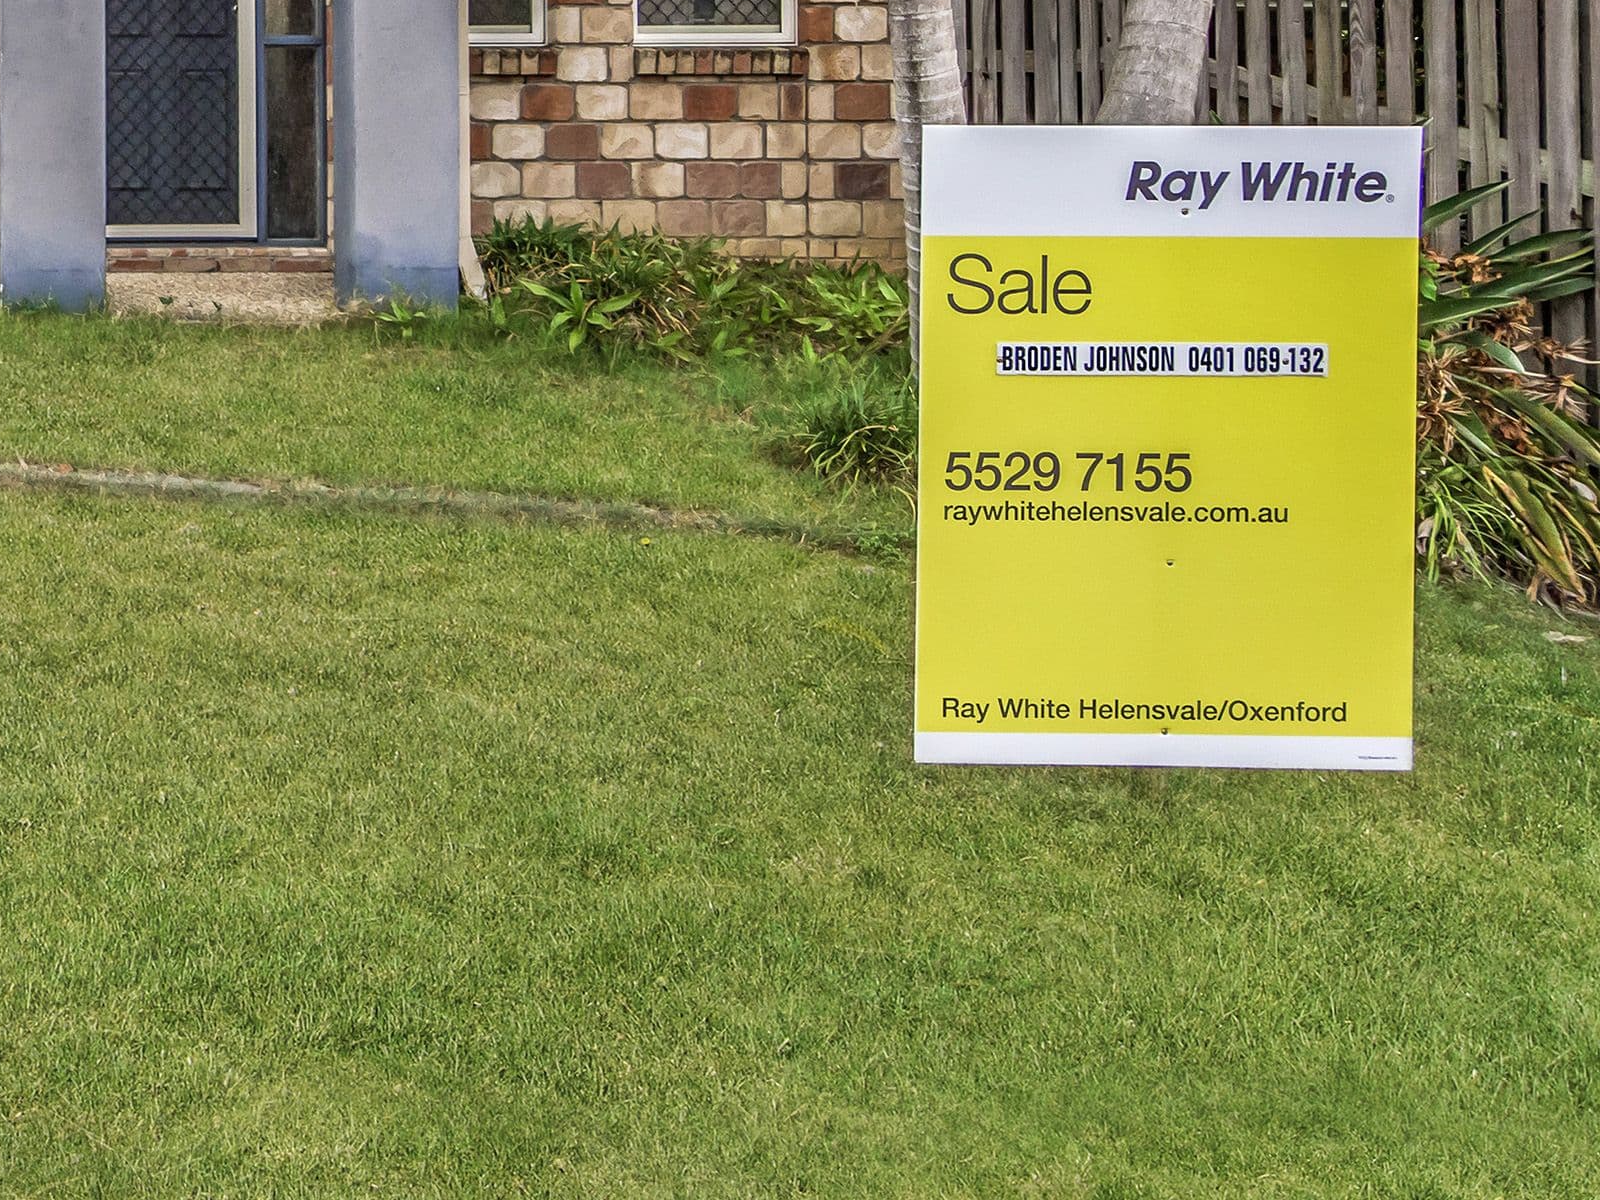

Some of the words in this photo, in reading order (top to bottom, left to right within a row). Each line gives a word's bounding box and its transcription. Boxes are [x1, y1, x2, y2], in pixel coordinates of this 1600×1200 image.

[1125, 160, 1230, 210] Ray
[1241, 161, 1387, 203] White
[947, 253, 1092, 315] Sale
[1001, 346, 1077, 372] BRODEN
[1083, 346, 1175, 372] JOHNSON
[1188, 346, 1234, 373] 0401
[944, 451, 1061, 492] 5529
[1075, 452, 1193, 493] 7155
[943, 500, 1289, 526] raywhitehelensvale.com.au
[942, 697, 990, 724] Ray
[997, 697, 1071, 720] White
[1079, 698, 1347, 723] Helensvale/Oxenford
